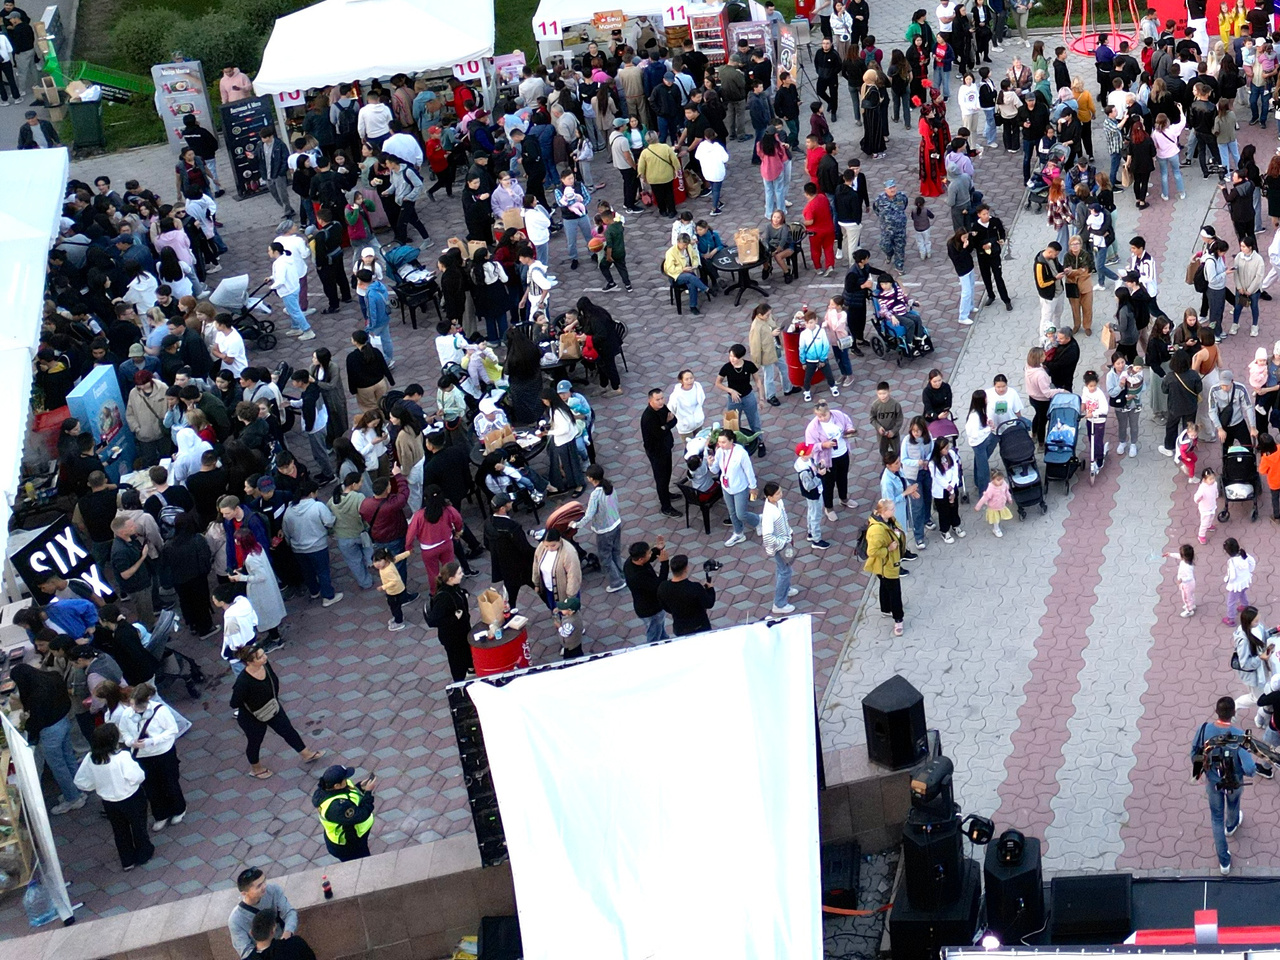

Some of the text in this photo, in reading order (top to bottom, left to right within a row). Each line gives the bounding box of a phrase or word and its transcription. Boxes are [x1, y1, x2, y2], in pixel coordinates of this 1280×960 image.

[666, 5, 685, 21] 11
[538, 20, 558, 36] 11
[456, 59, 480, 76] 10
[30, 526, 87, 574] SIX
